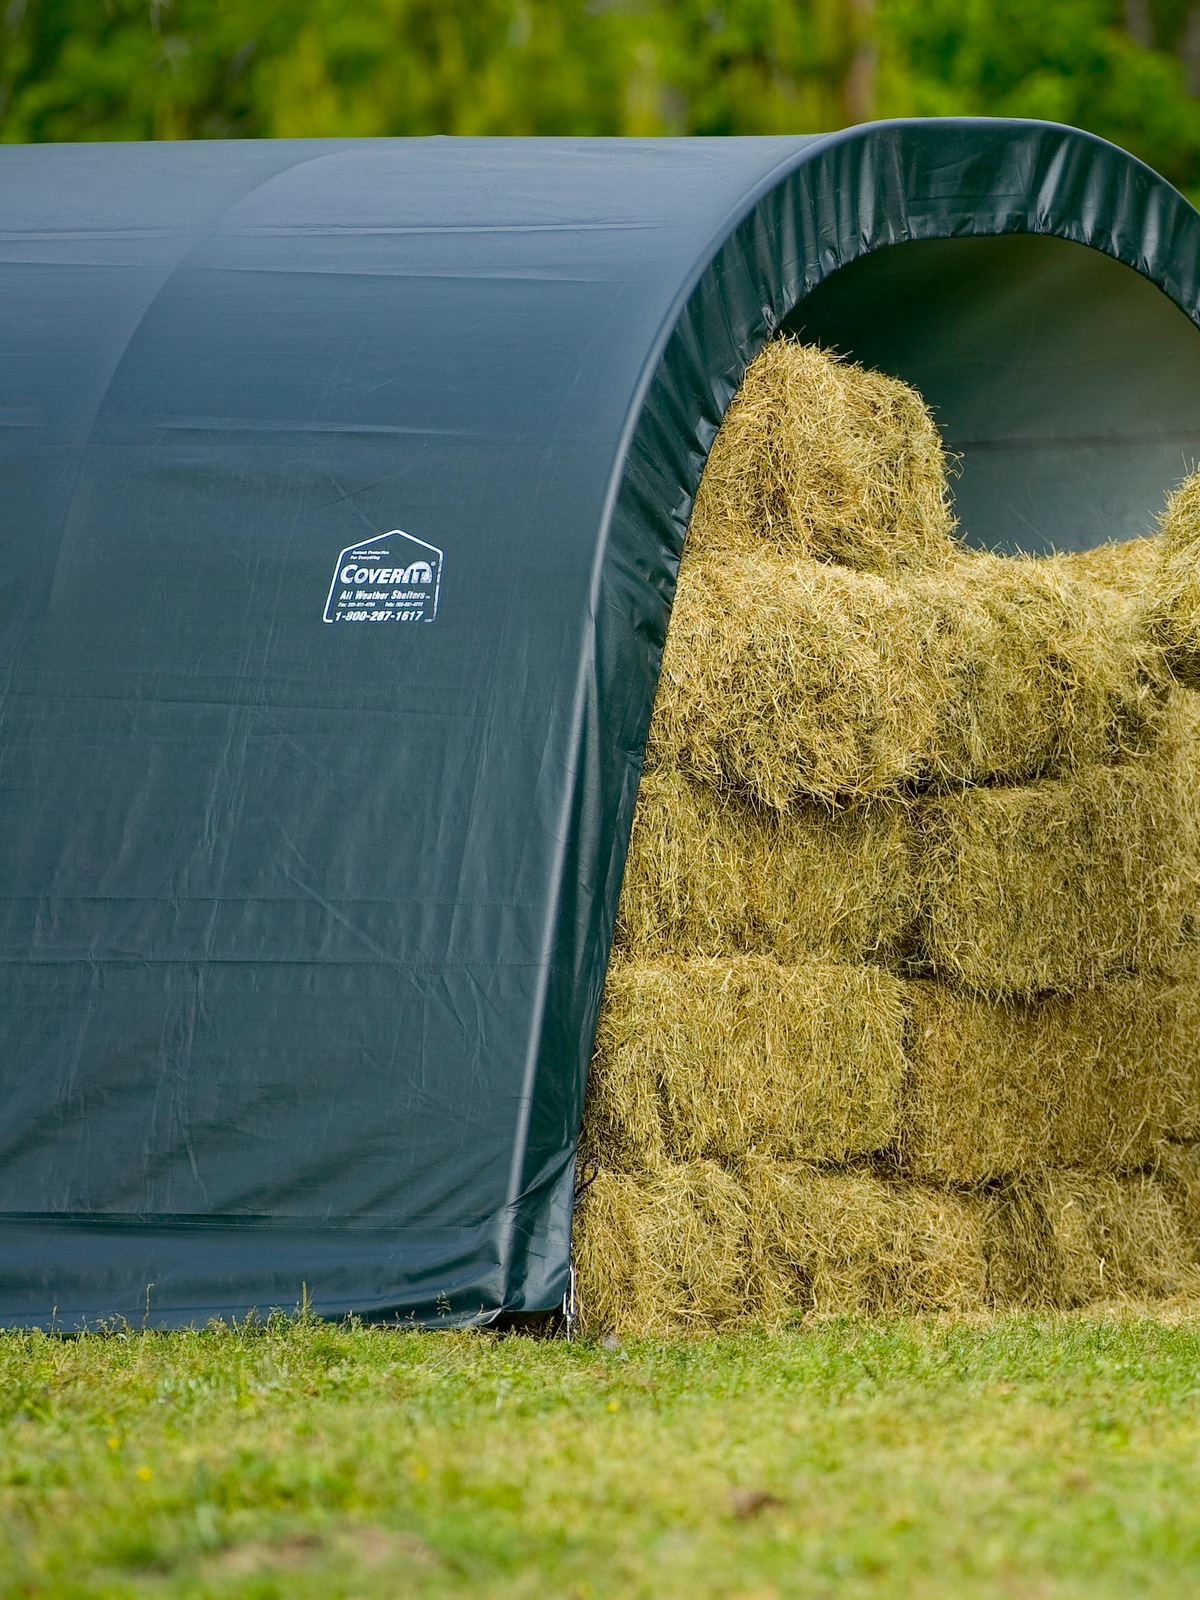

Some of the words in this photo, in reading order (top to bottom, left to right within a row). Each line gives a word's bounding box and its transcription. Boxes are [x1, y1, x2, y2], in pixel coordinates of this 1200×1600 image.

[339, 590, 353, 600] All
[355, 590, 389, 600] Weather
[391, 589, 426, 600] Shelters
[335, 611, 424, 621] 1-800-287-1617
